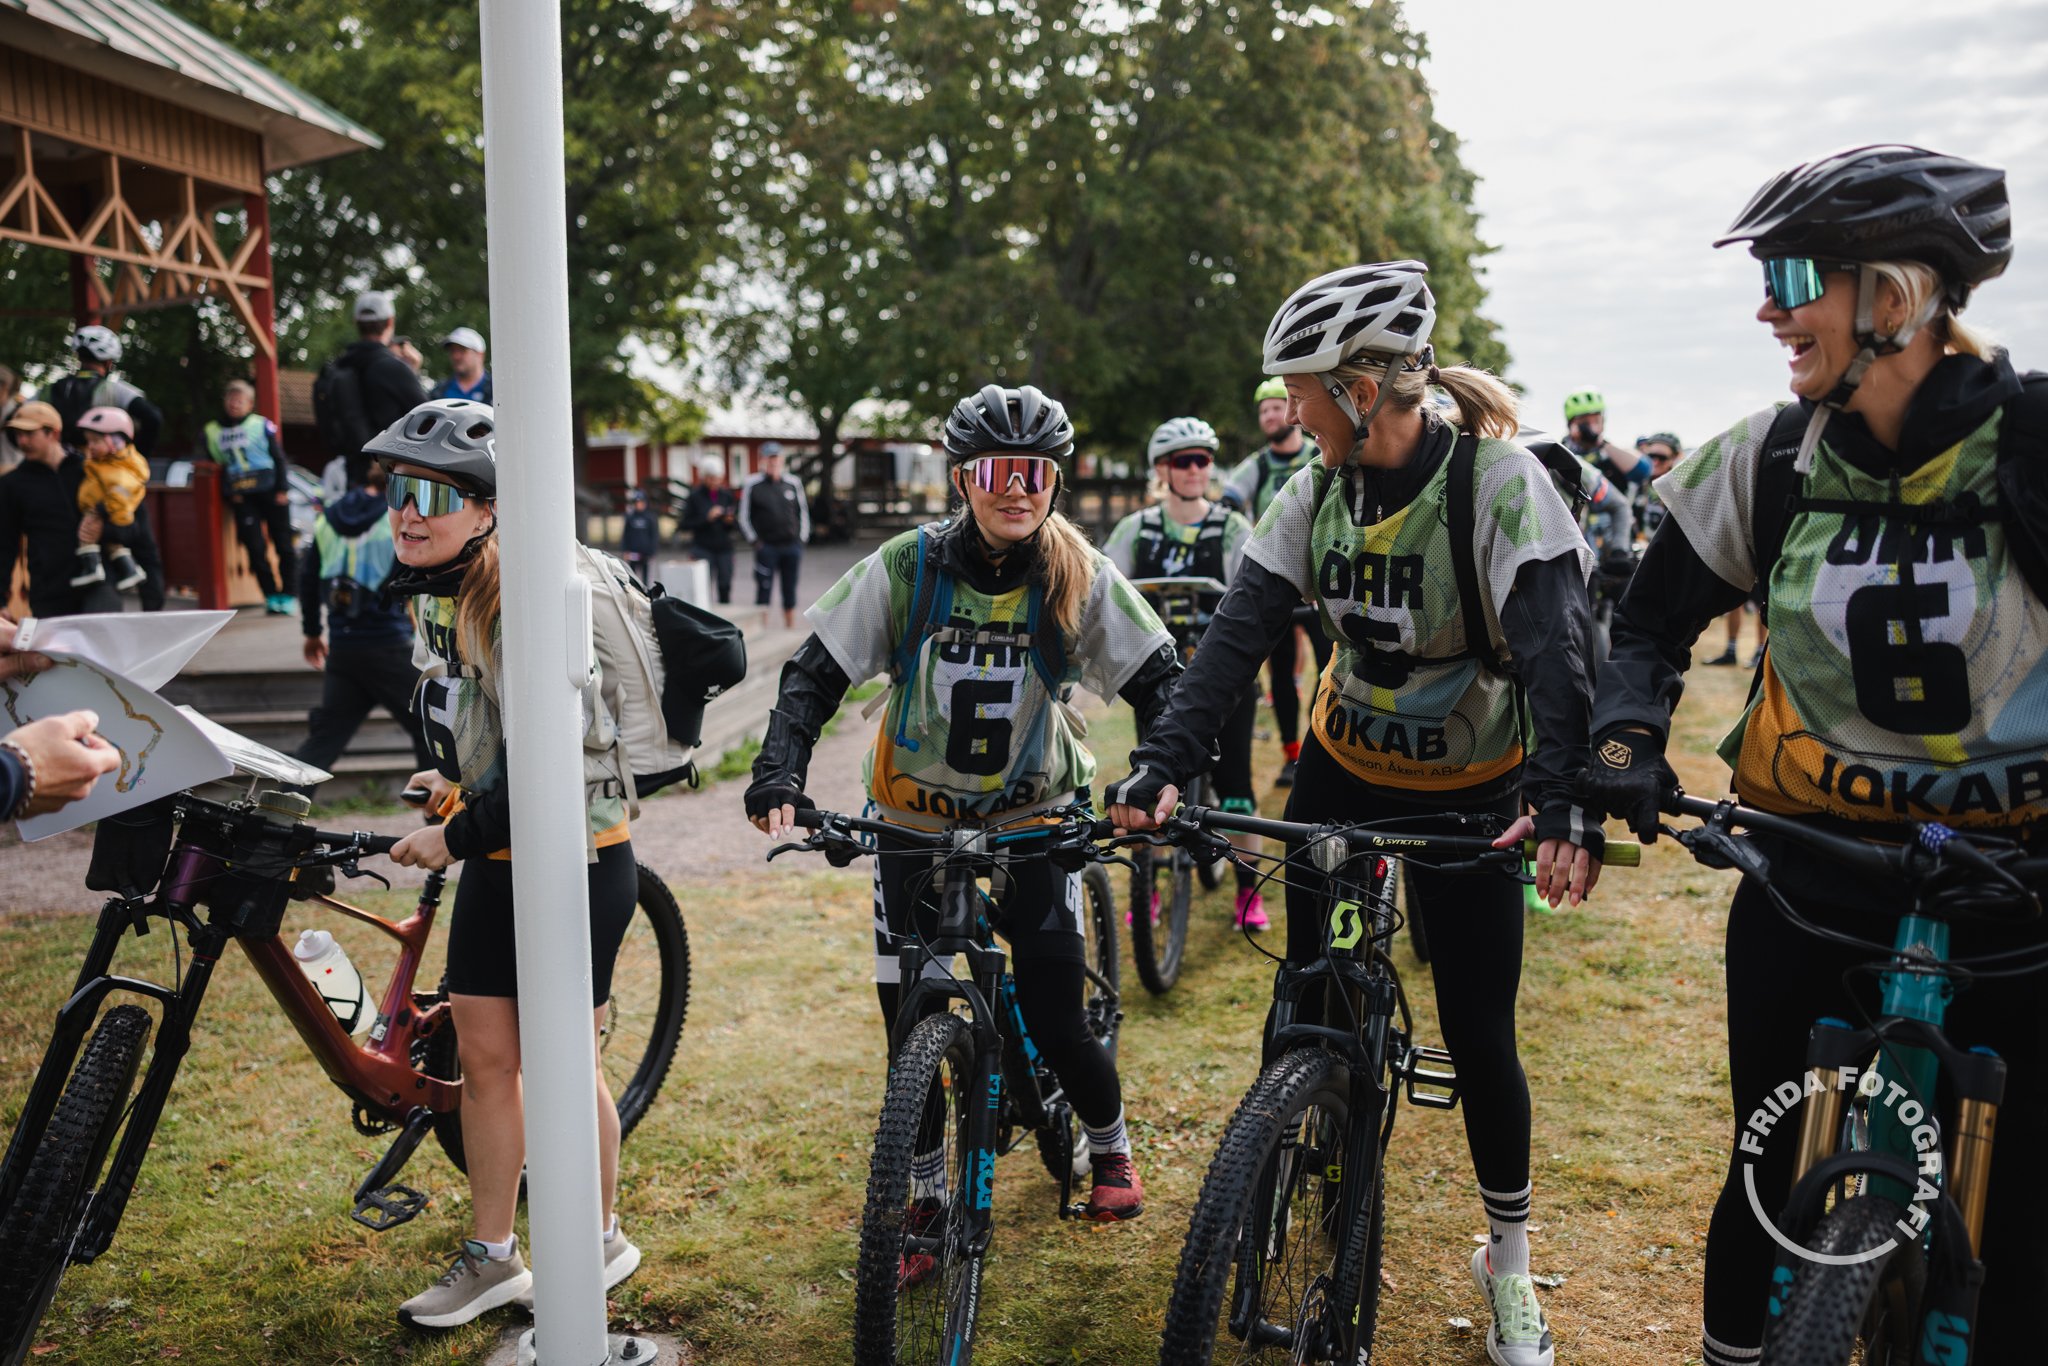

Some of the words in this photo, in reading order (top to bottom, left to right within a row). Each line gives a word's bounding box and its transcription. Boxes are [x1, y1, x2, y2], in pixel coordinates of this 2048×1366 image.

[1281, 321, 1326, 348] SCOTT
[1845, 582, 1972, 735] 6
[945, 679, 1014, 776] 6
[976, 1148, 996, 1210] FOX
